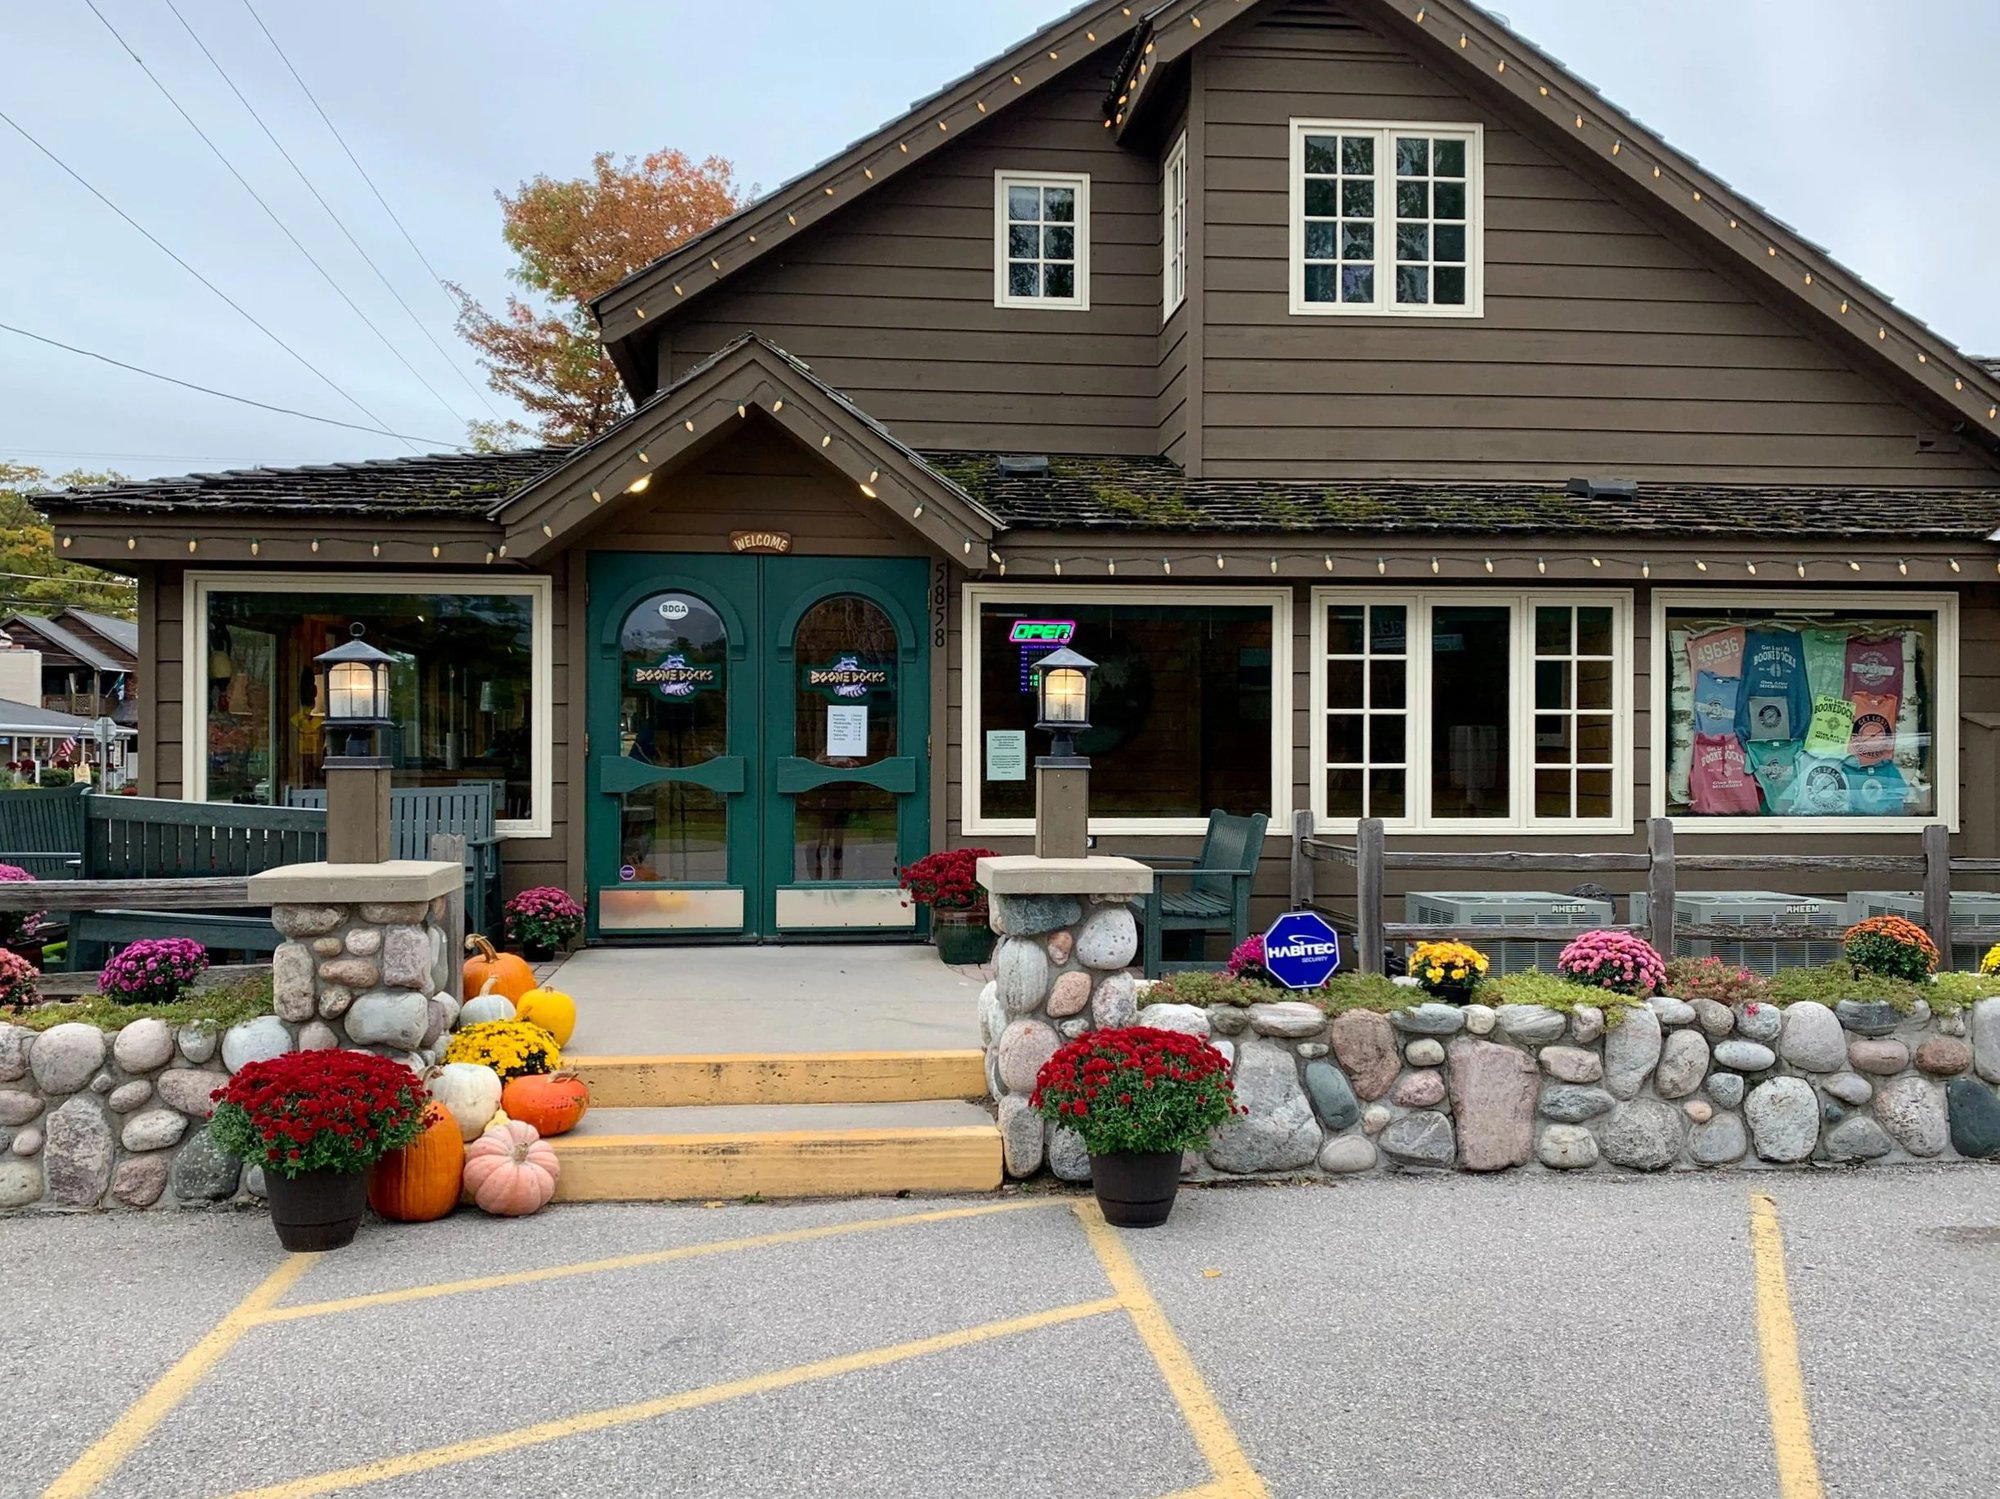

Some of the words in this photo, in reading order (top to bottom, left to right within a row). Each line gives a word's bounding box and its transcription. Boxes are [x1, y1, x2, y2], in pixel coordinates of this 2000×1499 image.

[733, 534, 788, 551] WELCOME
[935, 563, 945, 647] 5858
[1013, 625, 1072, 639] OPEN
[1698, 637, 1739, 662] 49636
[636, 668, 678, 681] BOONE
[679, 668, 714, 681] DOCKS
[810, 670, 850, 684] BOONE
[852, 671, 886, 682] DOCKS
[1551, 904, 1586, 913] RHEEM
[1786, 904, 1820, 913] RHEEM
[1268, 942, 1336, 958] HABITEC
